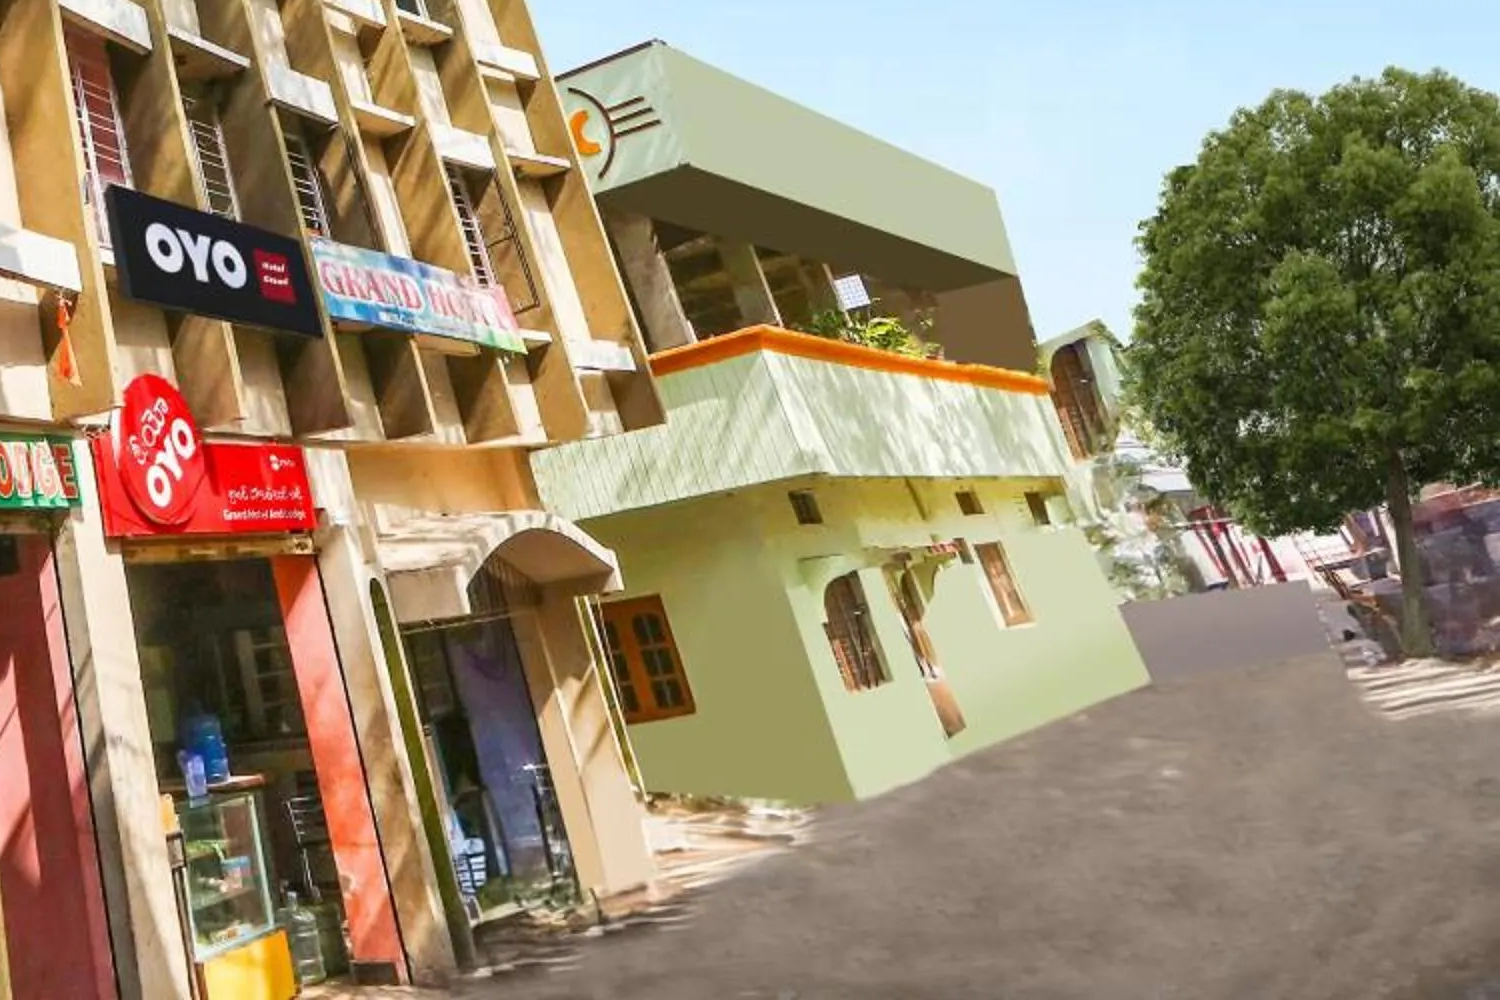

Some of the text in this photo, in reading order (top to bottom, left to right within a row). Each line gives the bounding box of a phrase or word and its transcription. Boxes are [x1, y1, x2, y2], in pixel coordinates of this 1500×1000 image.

[145, 222, 247, 289] OYO
[319, 259, 424, 311] GRAND
[146, 418, 196, 508] OYO
